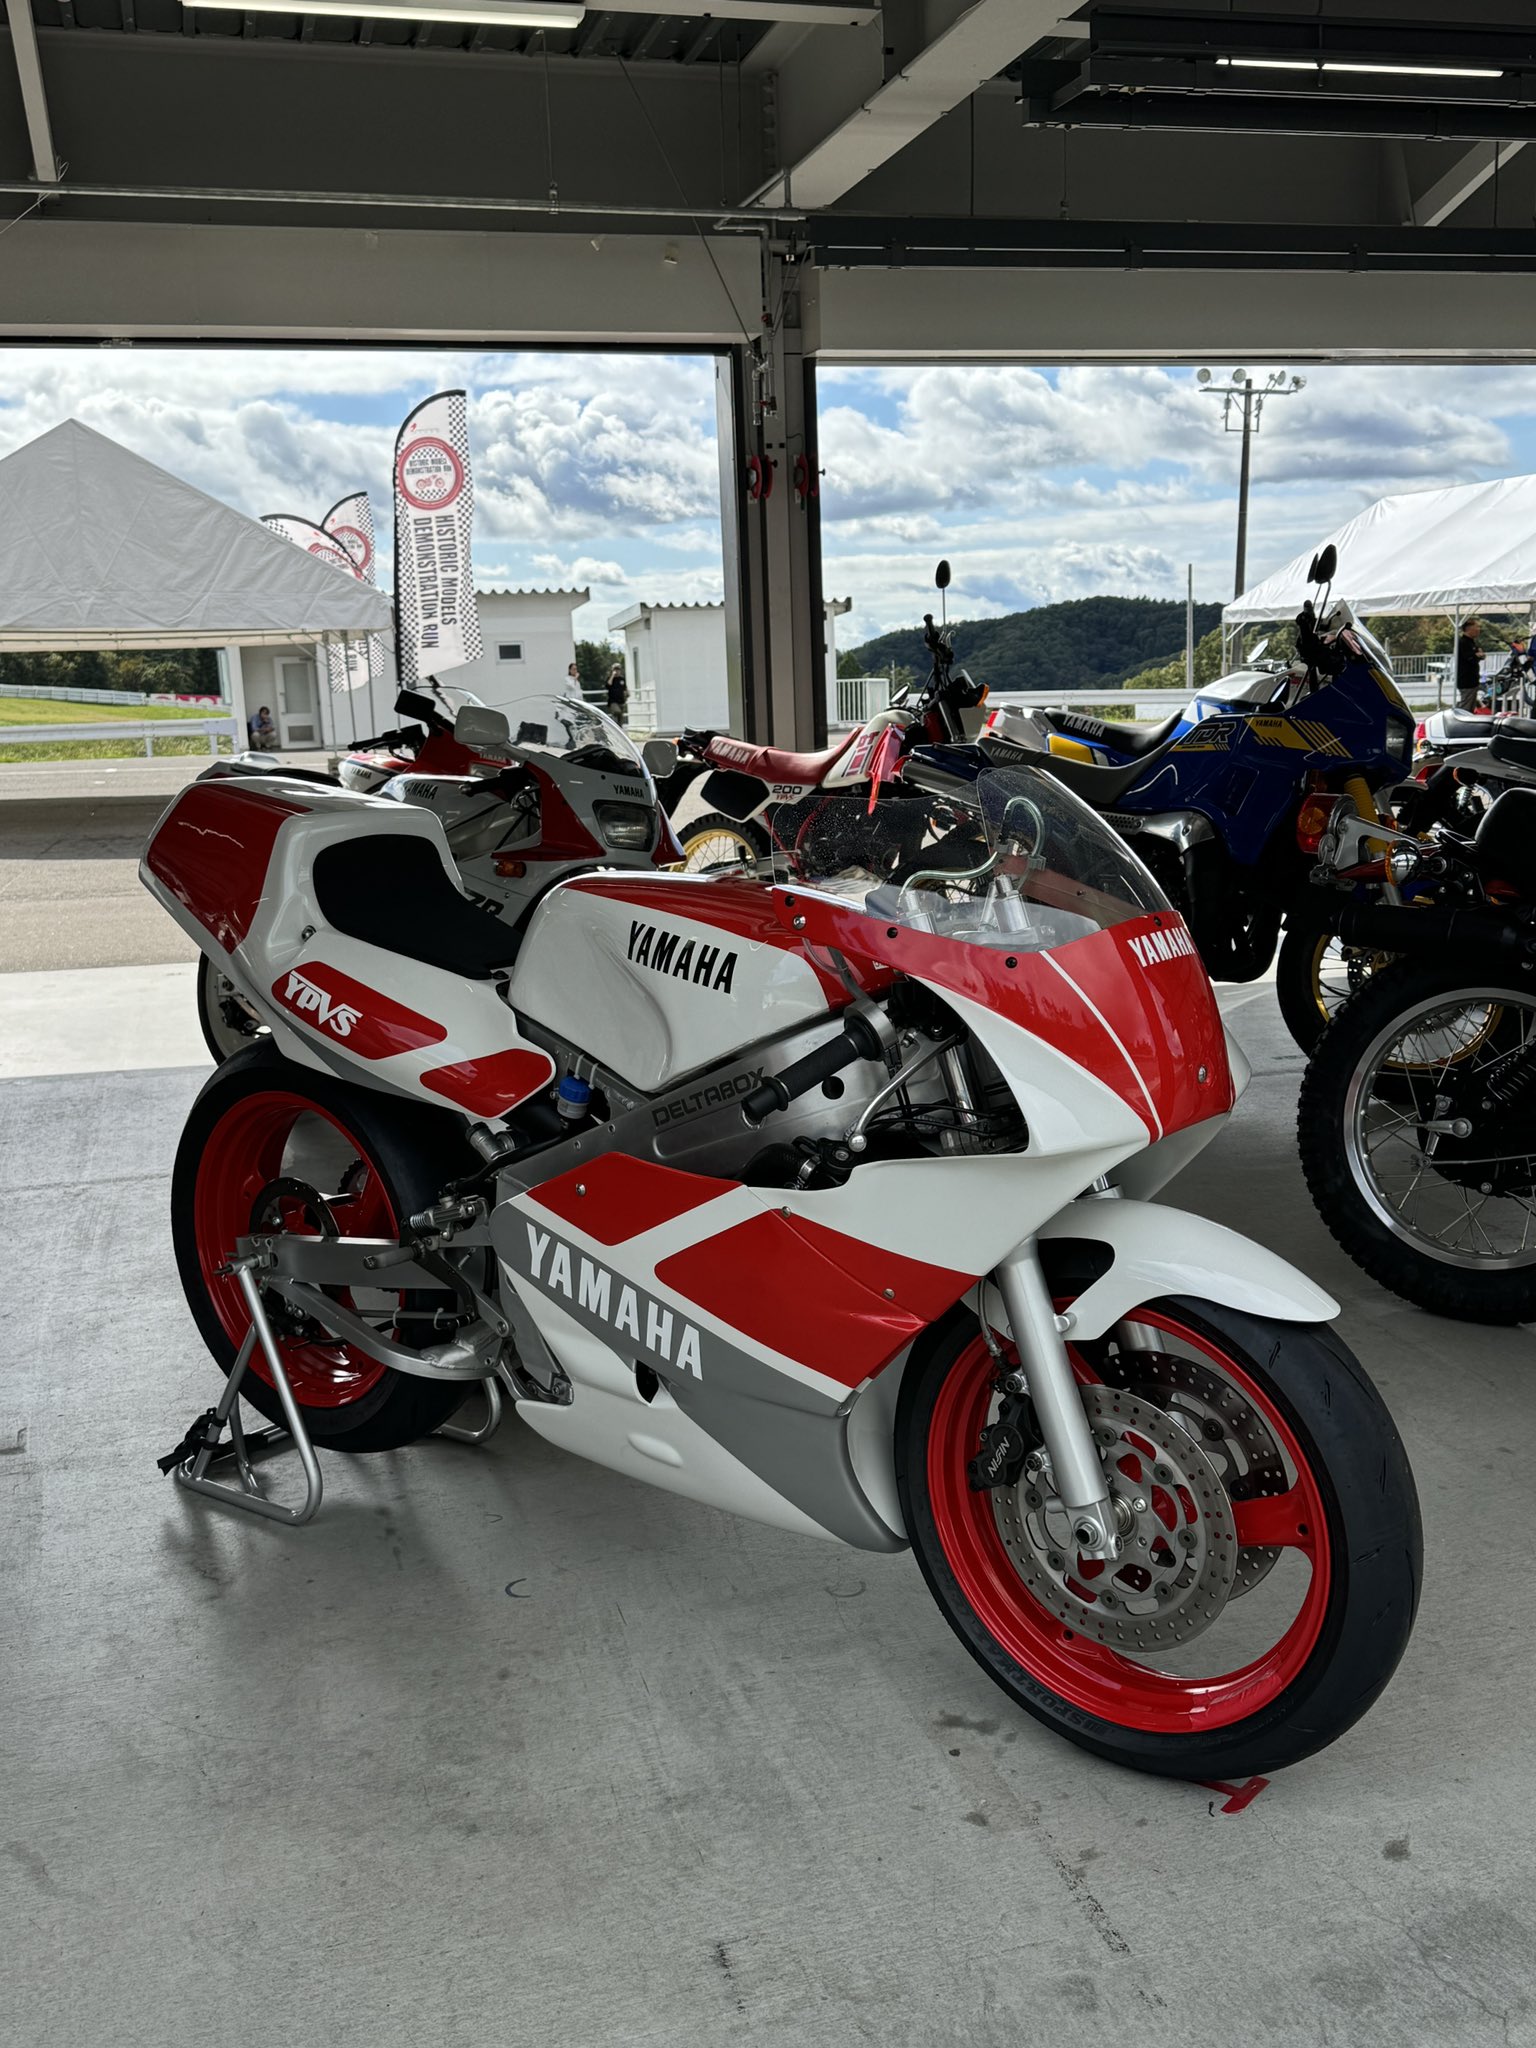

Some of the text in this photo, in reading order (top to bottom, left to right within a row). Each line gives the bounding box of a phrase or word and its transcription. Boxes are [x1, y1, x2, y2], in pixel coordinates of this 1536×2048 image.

[413, 517, 439, 649] DEMONSTRATION RUN
[435, 515, 458, 625] HISTORIC MODELS
[1063, 714, 1105, 738] YAMAHA
[1183, 721, 1237, 745] TDR
[1255, 719, 1283, 729] YAMAHA
[711, 739, 751, 765] YAMAHA
[990, 746, 1024, 761] YAMAHA
[613, 784, 645, 799] YAMAHA
[772, 784, 803, 795] 200
[627, 920, 739, 994] YAMAHA
[1127, 927, 1195, 967] YAMAHA
[284, 970, 364, 1036] YPVS
[652, 1066, 764, 1127] DELTABOX
[526, 1222, 703, 1381] YAMAHA
[987, 1436, 1011, 1479] NISSIN
